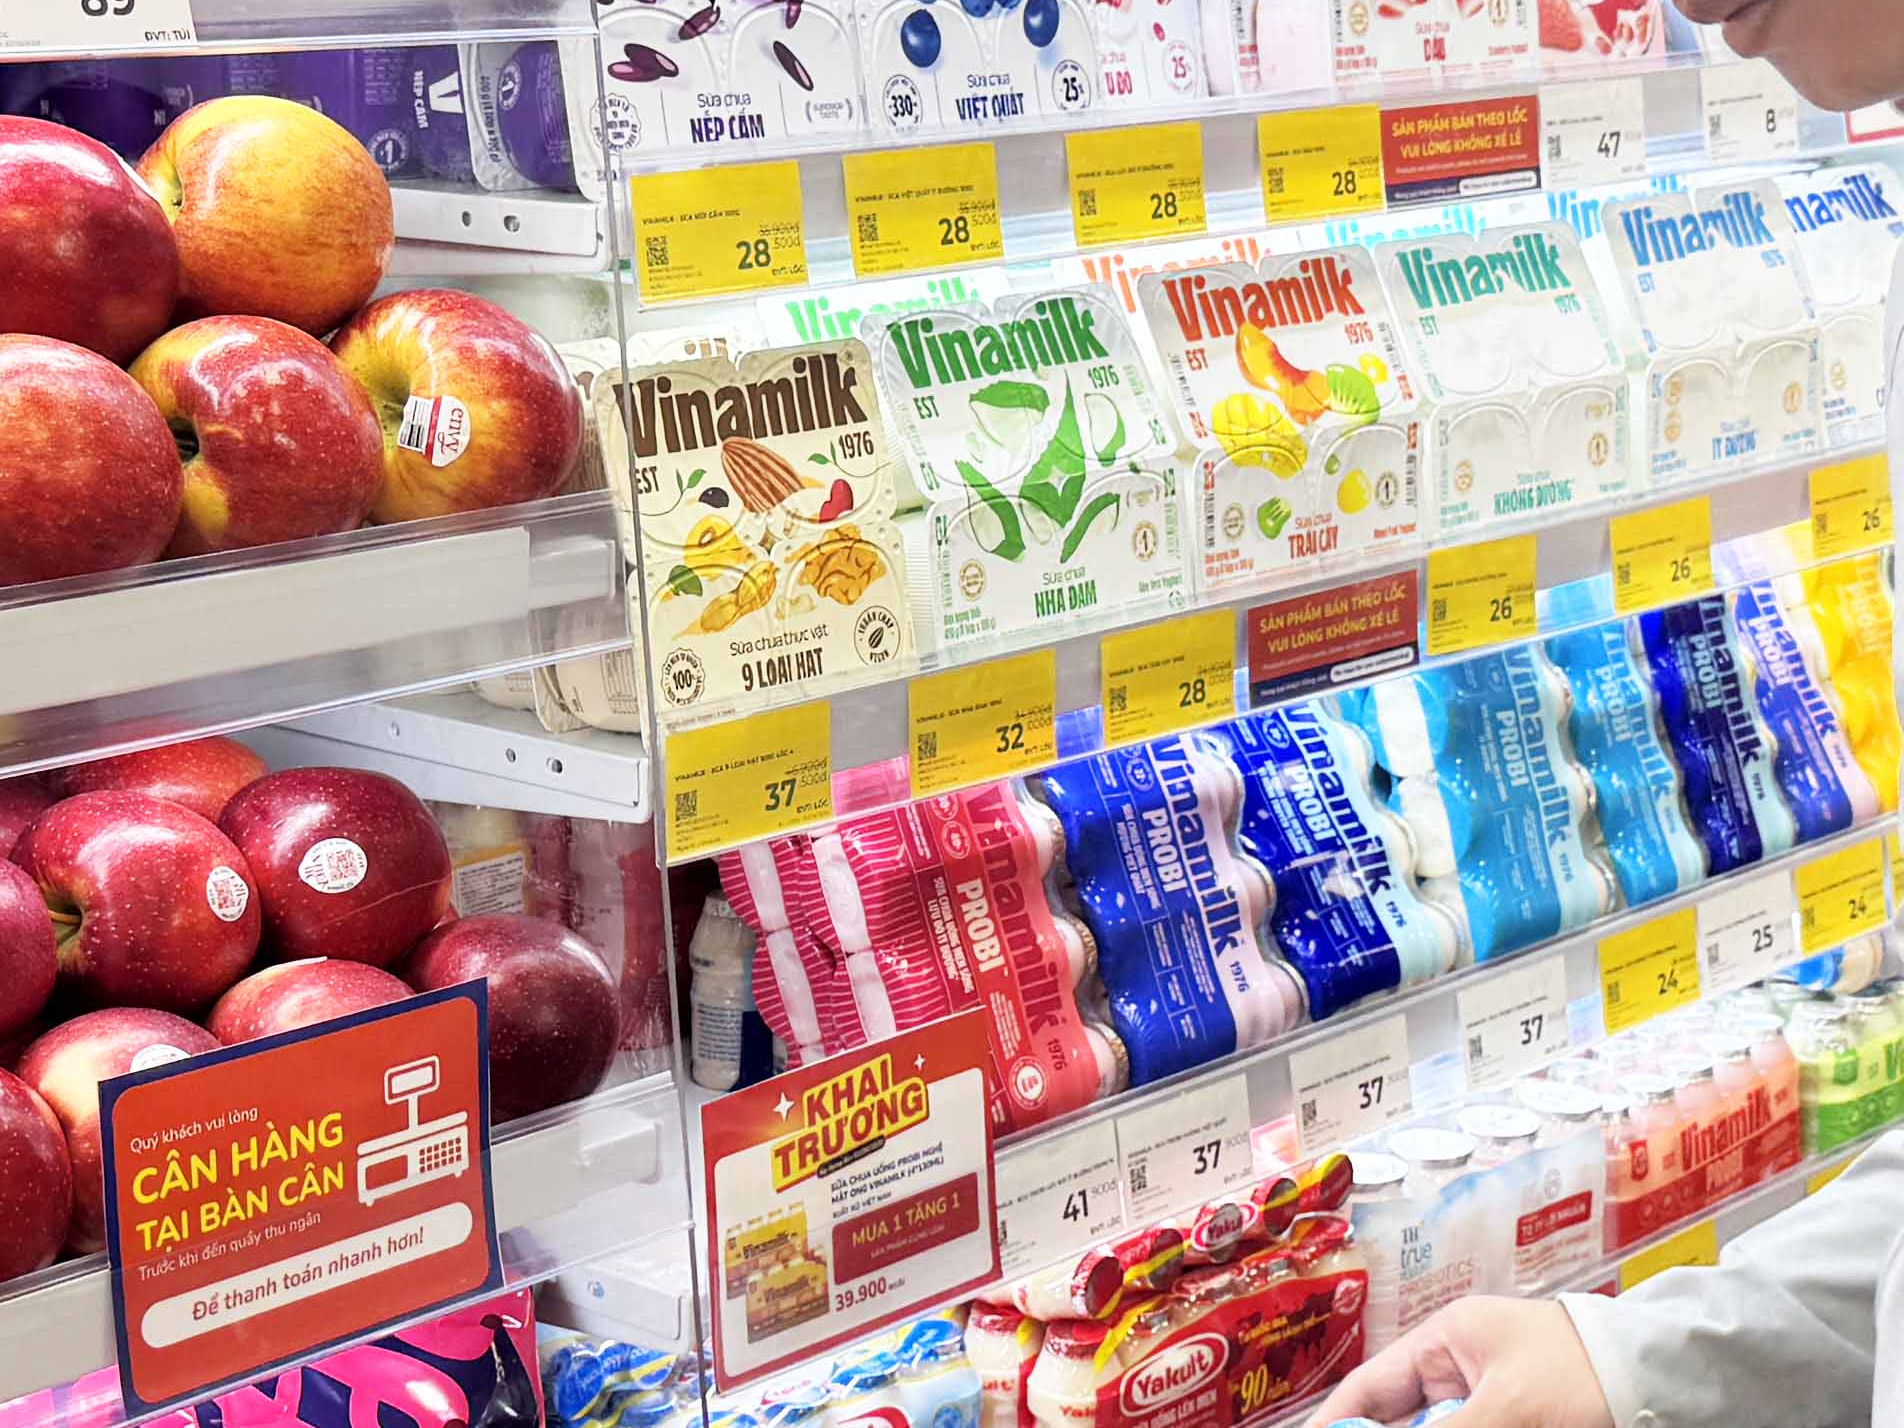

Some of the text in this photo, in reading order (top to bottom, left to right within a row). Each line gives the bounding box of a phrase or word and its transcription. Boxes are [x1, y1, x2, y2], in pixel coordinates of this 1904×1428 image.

[1597, 130, 1622, 159] 47
[1149, 190, 1179, 220] 28
[1331, 169, 1358, 198] 28
[938, 214, 971, 247] 28
[1620, 190, 1776, 268] Vinamilk
[735, 239, 772, 272] 28
[1396, 231, 1572, 311] Vinamilk
[1161, 252, 1366, 344] Vinamilk
[885, 297, 1110, 390] Vinamilk
[612, 349, 870, 459] Vinamilk
[837, 431, 876, 462] 1976
[1489, 597, 1513, 623] 26
[1177, 679, 1207, 710] 28
[995, 722, 1026, 756] 32
[763, 778, 797, 813] 37
[1142, 807, 1183, 894] PROBI
[957, 877, 1005, 974] PROBI
[1046, 1036, 1069, 1071] 1976
[804, 1058, 894, 1127] KHAI
[1356, 1074, 1387, 1111] 37
[130, 1105, 259, 1155] Quý khách vui lòng
[773, 1082, 927, 1178] TRƯƠNG
[132, 1112, 345, 1204] CÂN HÀNG
[1191, 1138, 1223, 1175] 37
[136, 1160, 345, 1254] TẠI BÀN CÂN
[851, 1221, 890, 1248] MUA
[893, 1213, 902, 1231] 1
[905, 1196, 948, 1227] TẶNG
[951, 1191, 961, 1209] 1
[1061, 1188, 1091, 1225] 41
[137, 1209, 322, 1282] Trước khi đến quầy thu ngân
[192, 1226, 425, 1323] Để thanh toán nhanh hơn!
[835, 1275, 888, 1312] 39.900
[1136, 1349, 1211, 1400] Yakult
